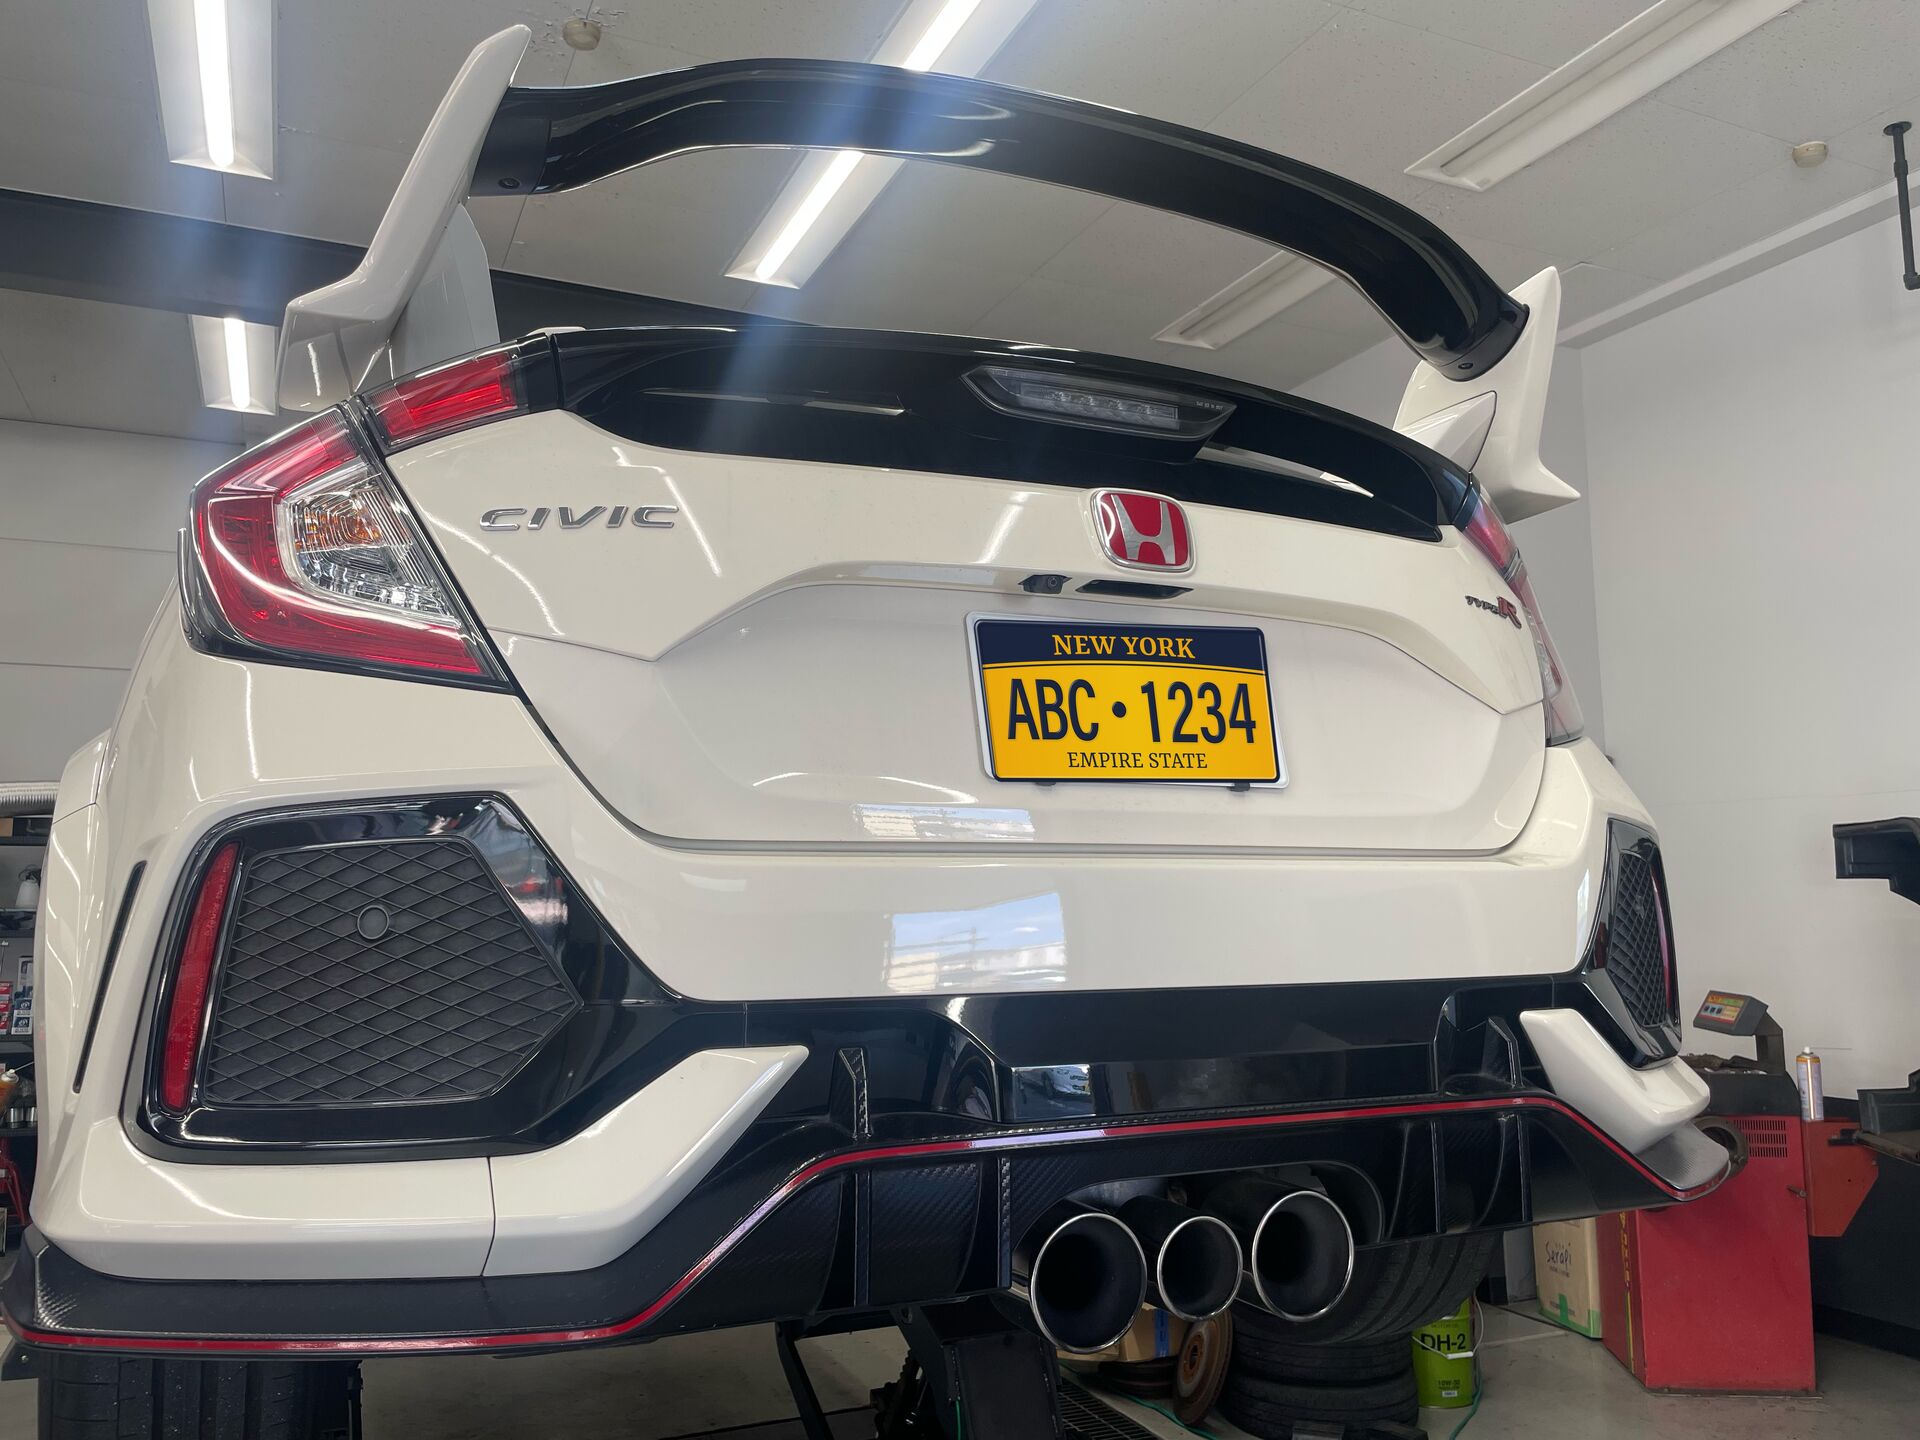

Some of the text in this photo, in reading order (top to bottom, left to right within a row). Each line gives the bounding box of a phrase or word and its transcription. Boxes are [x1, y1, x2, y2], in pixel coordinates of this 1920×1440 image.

[479, 505, 680, 531] CIVIC
[1051, 634, 1196, 659] NEW YORK
[1007, 678, 1099, 741] ABC
[1141, 680, 1256, 743] 1234
[1067, 752, 1208, 769] EMPIRE STATE
[1420, 1333, 1466, 1351] DH-2
